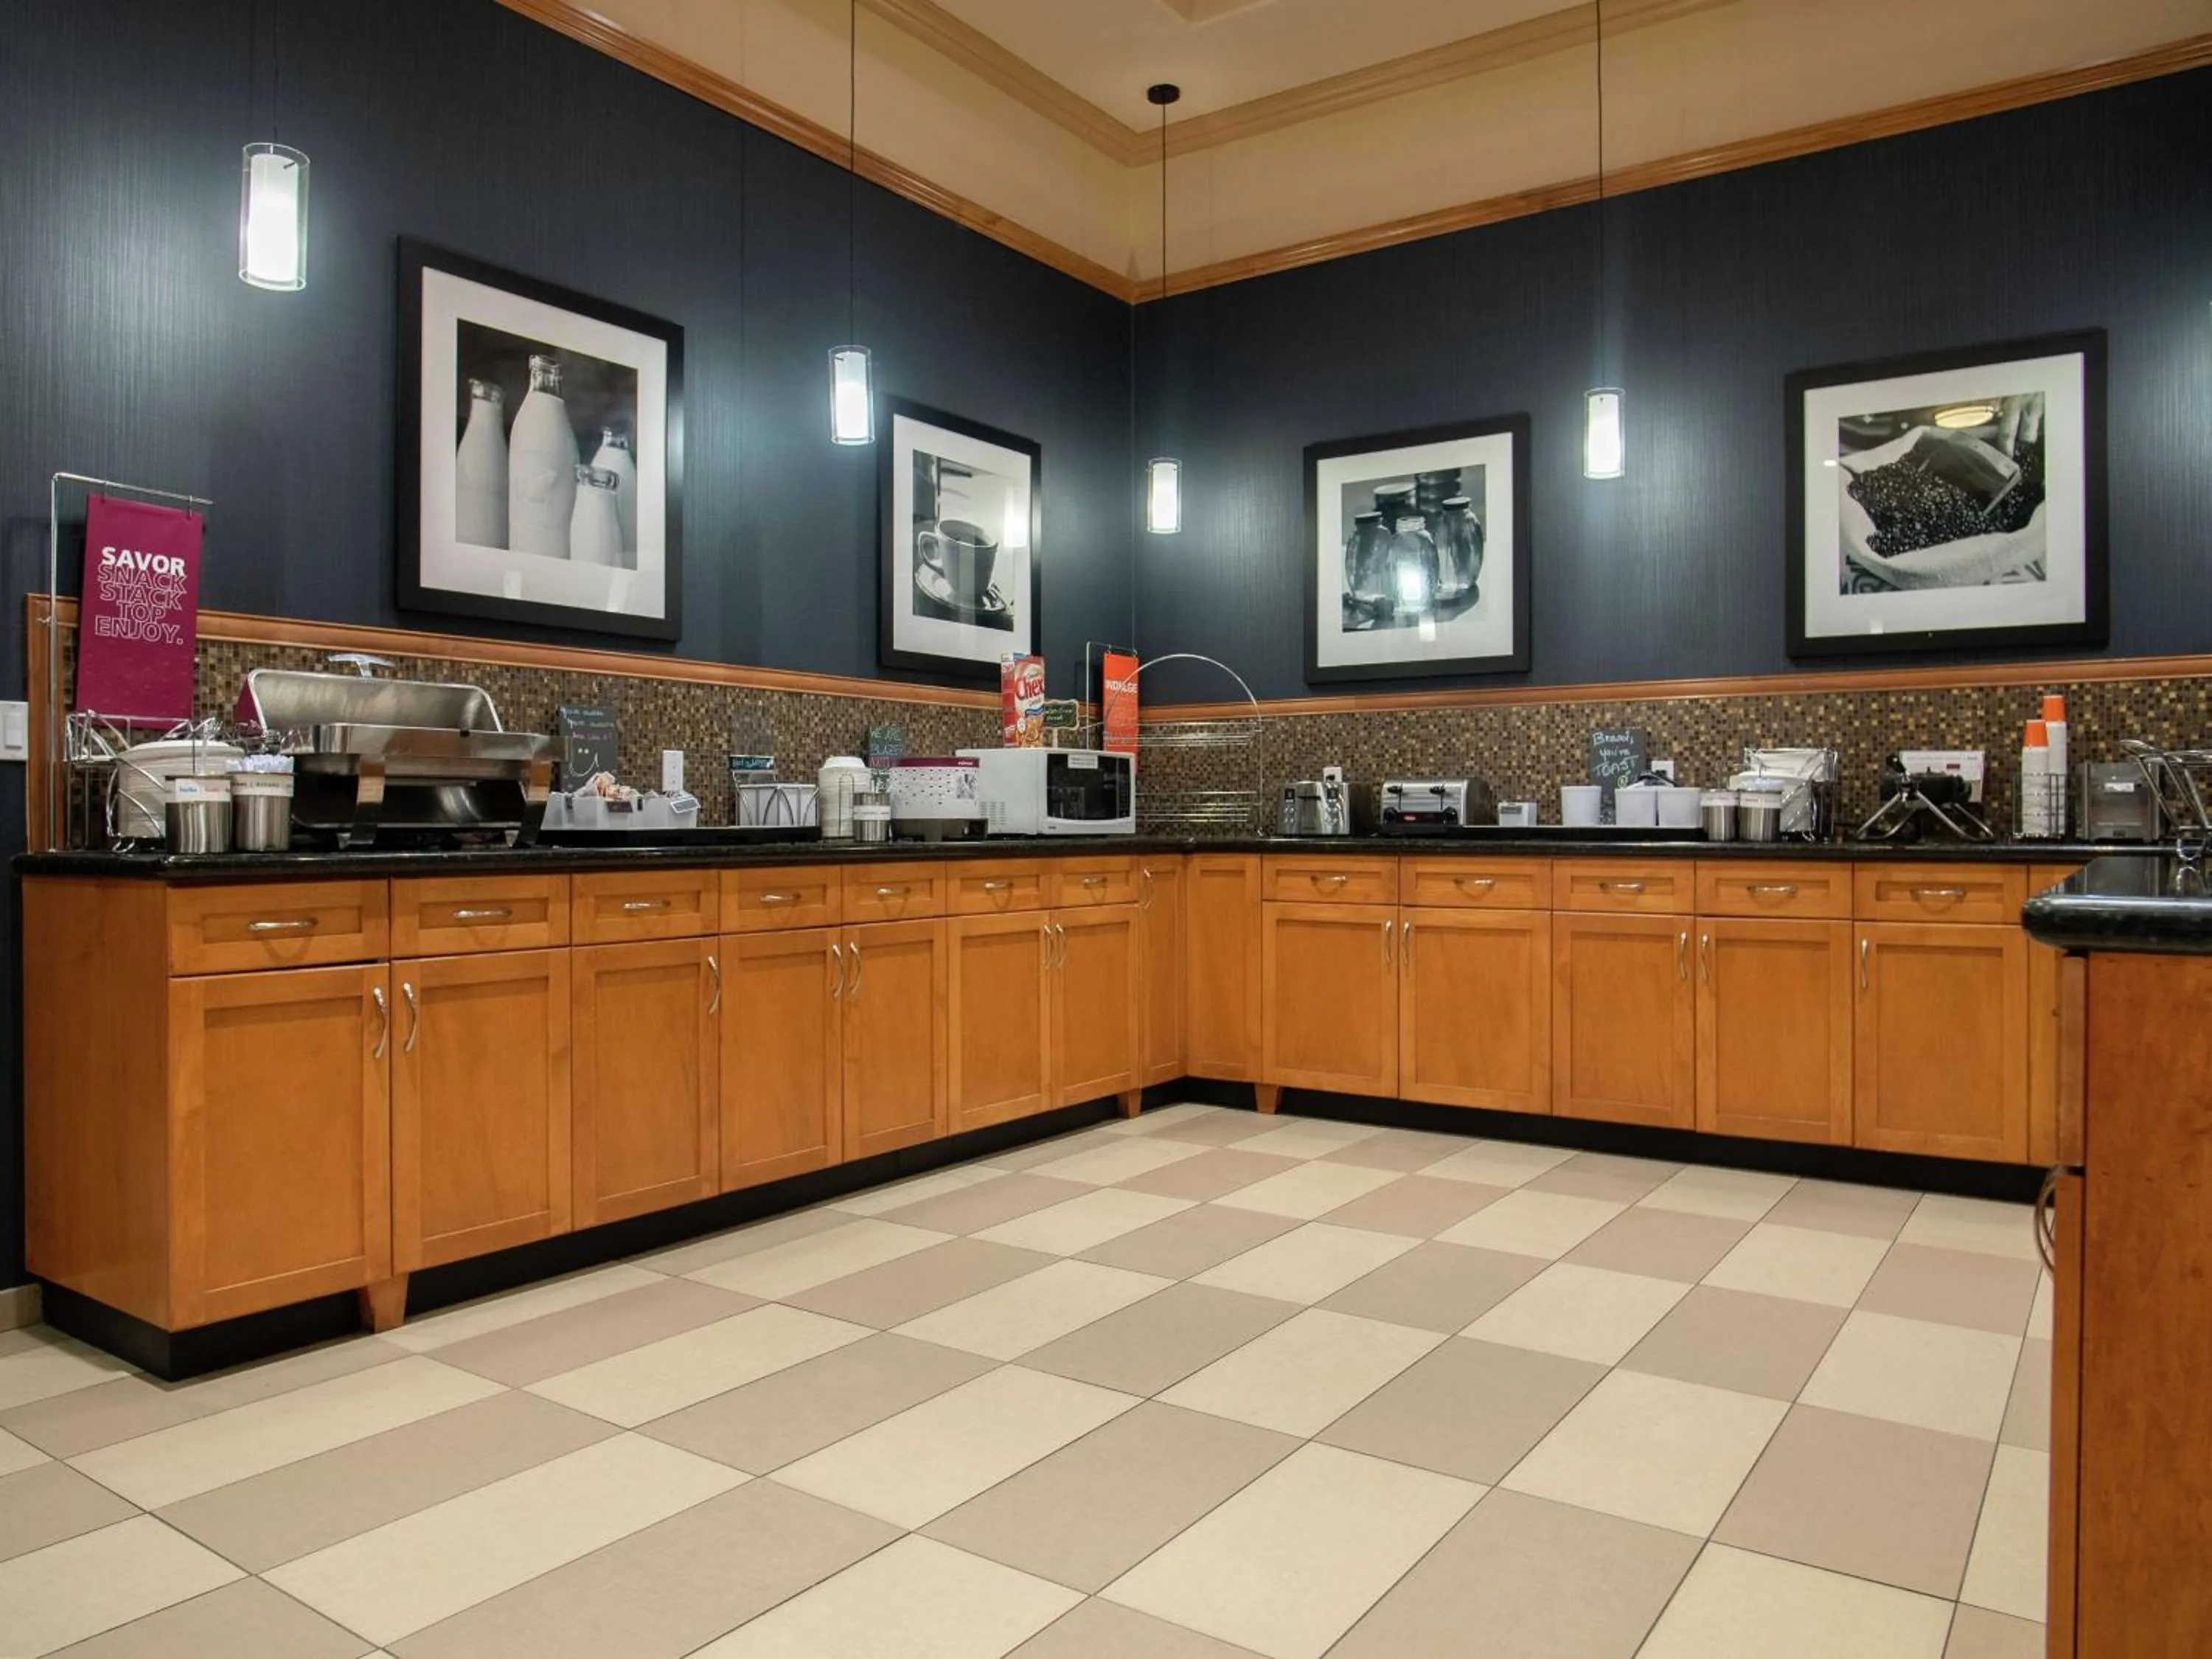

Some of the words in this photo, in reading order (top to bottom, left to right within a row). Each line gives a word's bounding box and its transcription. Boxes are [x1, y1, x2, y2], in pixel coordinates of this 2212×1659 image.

[102, 546, 185, 576] SAVOR
[97, 563, 187, 594] SNACK
[100, 580, 182, 611] STACK
[116, 600, 165, 624] TOP
[95, 615, 184, 645] ENJOY.
[1016, 676, 1044, 700] Chex
[1593, 755, 1639, 778] TOAST
